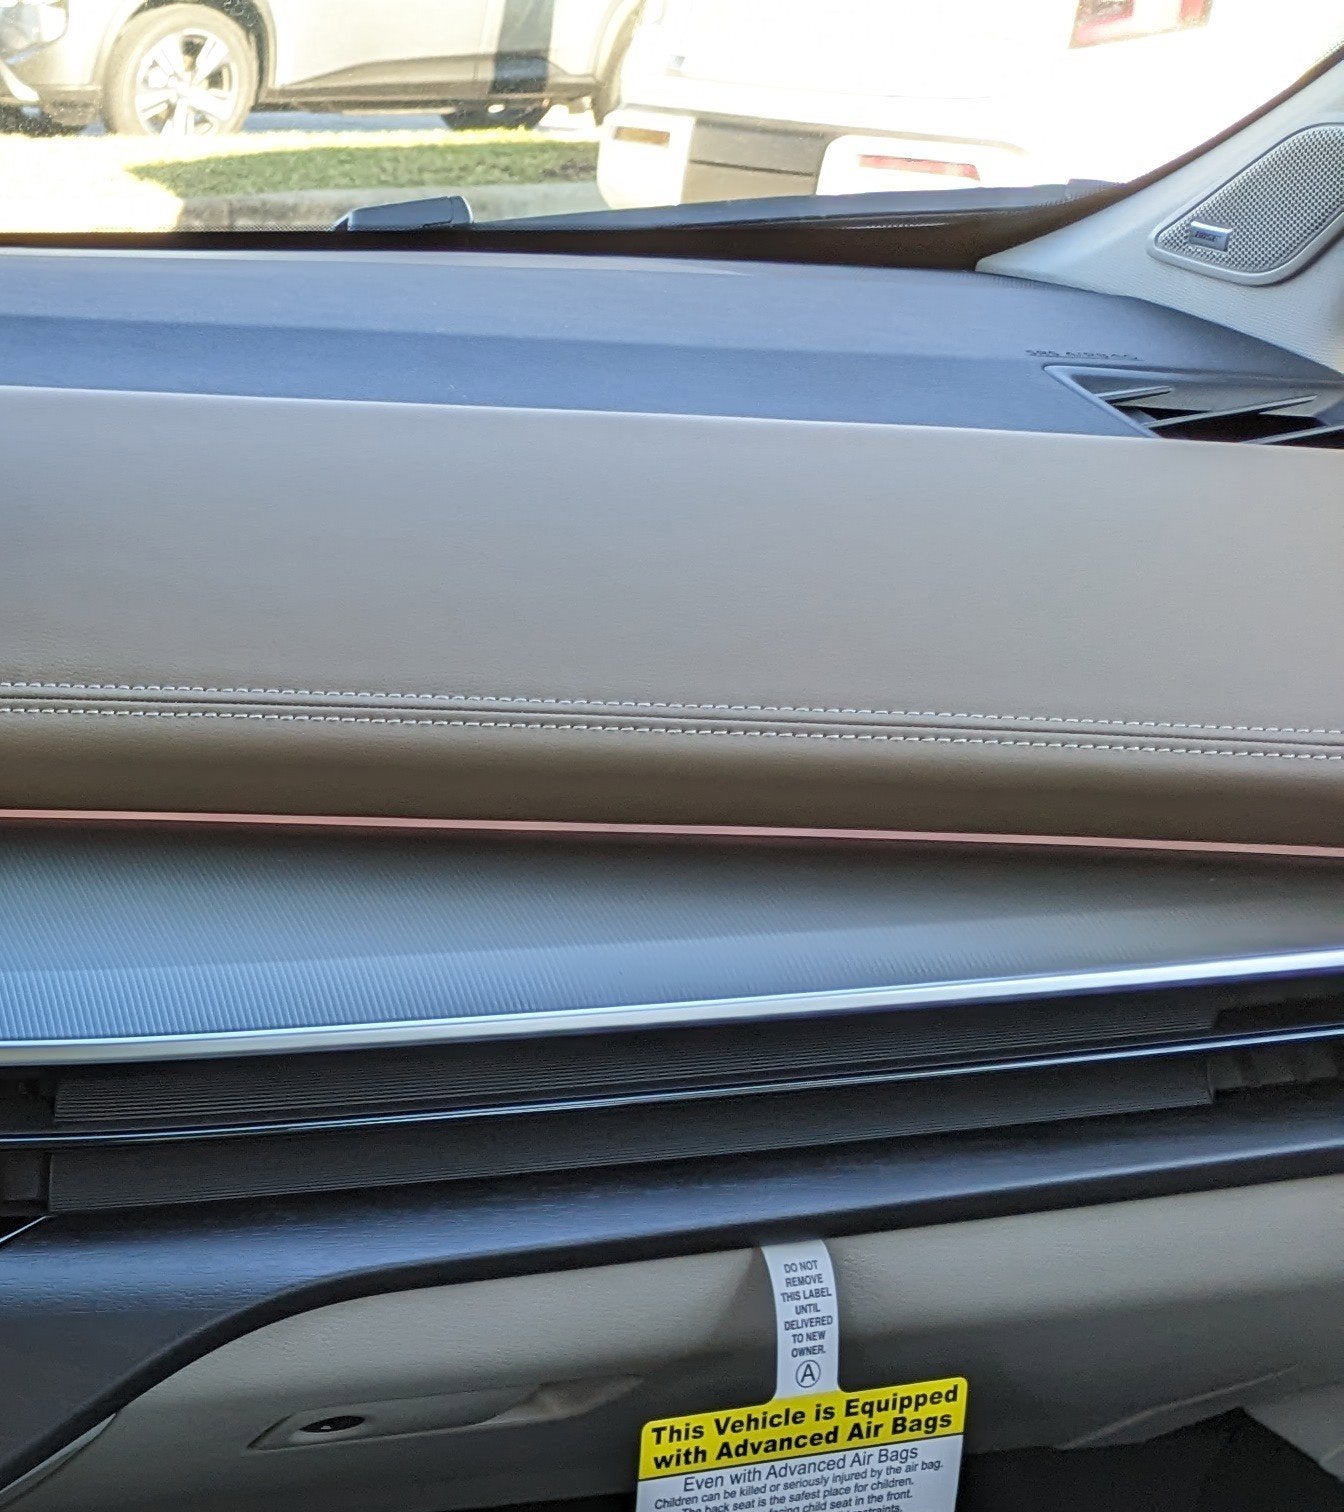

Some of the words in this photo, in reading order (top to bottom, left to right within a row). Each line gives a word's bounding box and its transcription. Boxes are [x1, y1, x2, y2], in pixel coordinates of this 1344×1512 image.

[783, 1263, 798, 1274] DO
[799, 1260, 818, 1271] NOT
[785, 1273, 824, 1288] REMOVE
[780, 1291, 801, 1303] THIS
[802, 1287, 832, 1300] LABEL
[795, 1303, 821, 1315] UNTIL
[783, 1315, 833, 1331] DELIVERED
[792, 1332, 803, 1344] TO
[805, 1330, 826, 1341] NEW
[791, 1344, 826, 1358] OWNER.
[800, 1363, 816, 1383] A
[651, 1423, 705, 1445] This
[714, 1408, 806, 1436] Vehicle
[815, 1404, 835, 1421] is
[844, 1384, 959, 1418] Equipped
[653, 1446, 707, 1470] with
[715, 1425, 839, 1461] Advanced
[846, 1421, 884, 1442] Air
[891, 1413, 952, 1435] Bags
[683, 1475, 724, 1492] Even
[729, 1467, 761, 1485] with
[765, 1454, 846, 1480] Advanced
[849, 1452, 873, 1468] Air
[878, 1447, 918, 1464] Bags
[654, 1495, 699, 1510] Children
[701, 1493, 721, 1502] can
[723, 1489, 736, 1499] be
[739, 1484, 766, 1496] killed
[769, 1483, 781, 1492] or
[783, 1474, 829, 1491] seriously
[832, 1469, 867, 1484] injured
[870, 1466, 883, 1479] by
[886, 1464, 902, 1475] the
[905, 1462, 919, 1473] air
[921, 1459, 943, 1471] bag.
[732, 1499, 755, 1511] seat
[757, 1496, 766, 1507] is
[769, 1494, 785, 1505] the
[789, 1487, 820, 1502] safest
[823, 1485, 851, 1499] place
[854, 1482, 868, 1493] for
[870, 1476, 914, 1491] children.
[830, 1497, 852, 1509] seat
[855, 1494, 864, 1505] in
[867, 1492, 884, 1504] the
[886, 1488, 913, 1501] front.
